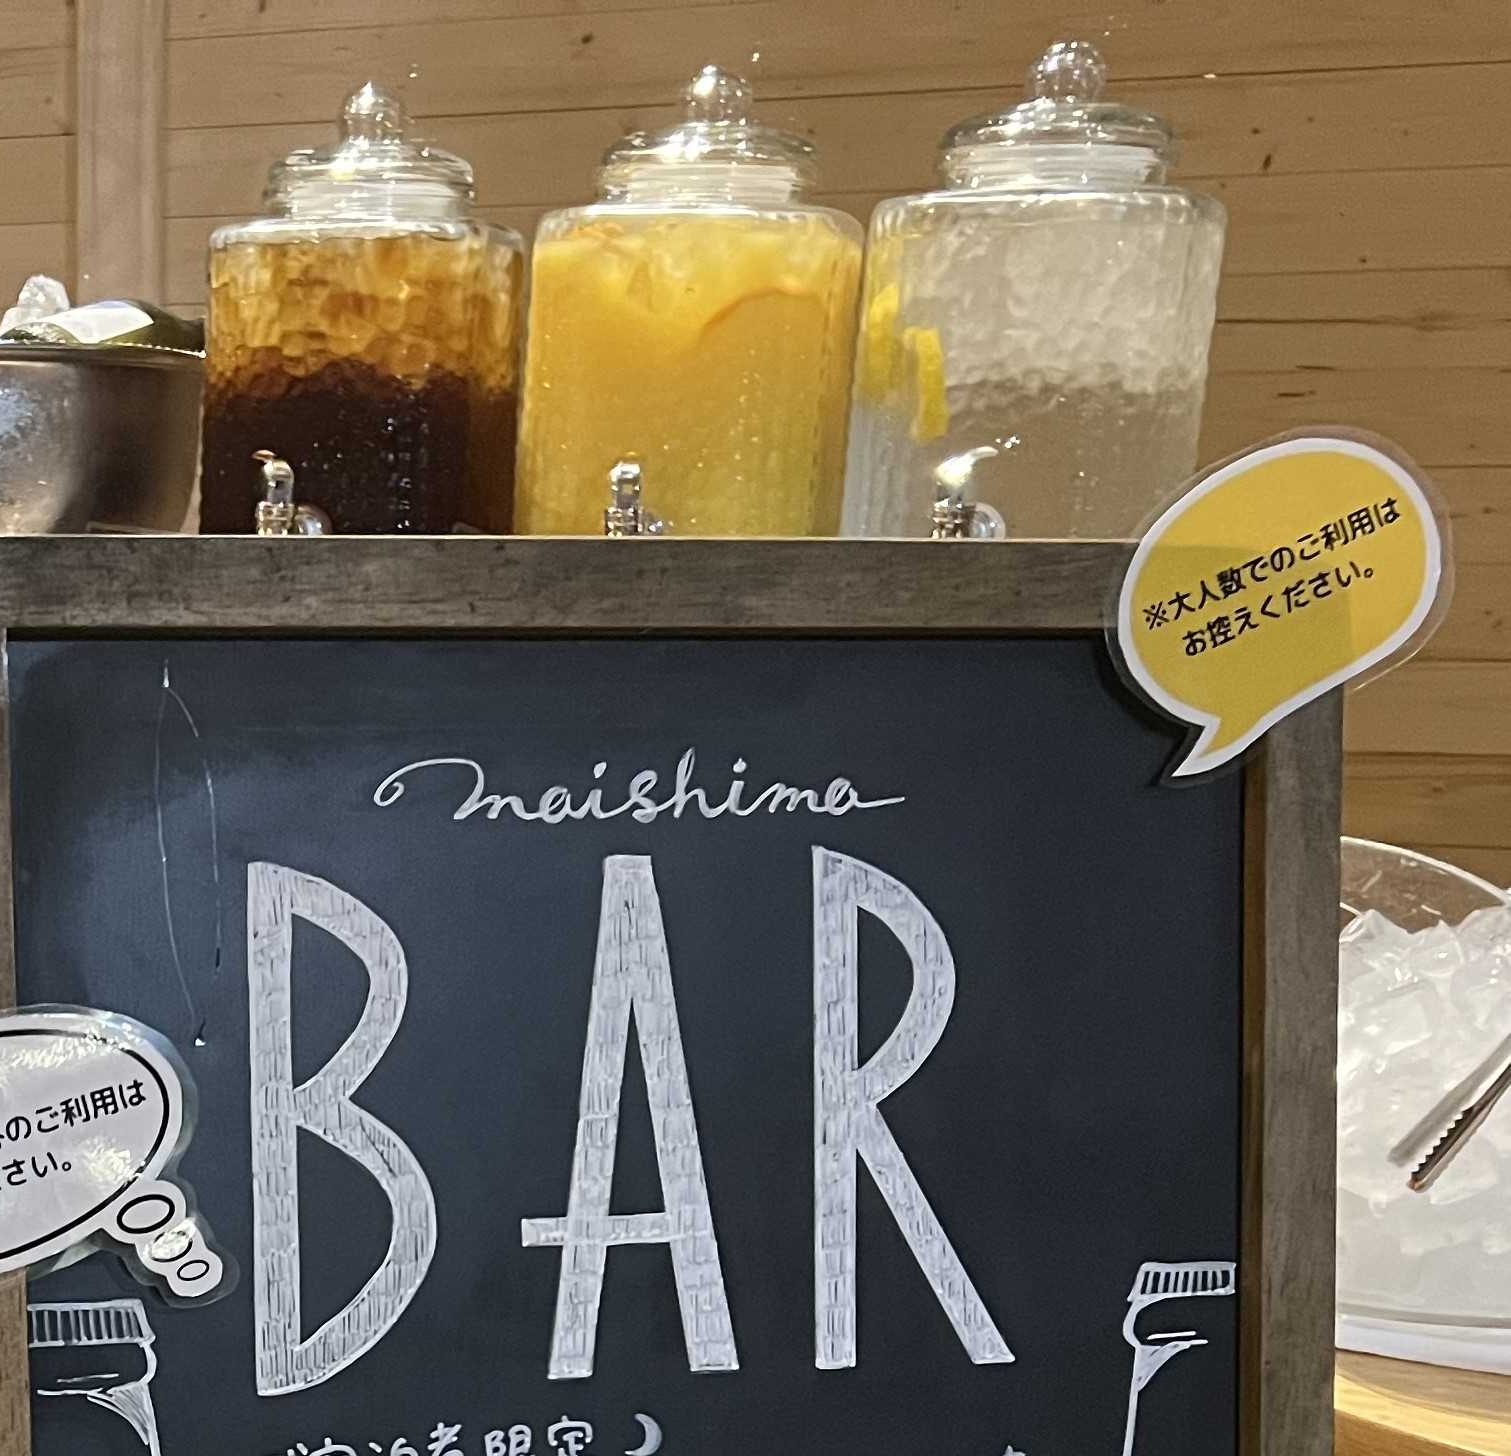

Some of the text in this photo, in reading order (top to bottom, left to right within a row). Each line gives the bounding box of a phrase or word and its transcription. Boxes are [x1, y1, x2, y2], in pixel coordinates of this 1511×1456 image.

[1143, 497, 1400, 631] ※大人数でのご利用は
[1182, 561, 1374, 656] お控えください。
[248, 845, 1015, 1396] BAR
